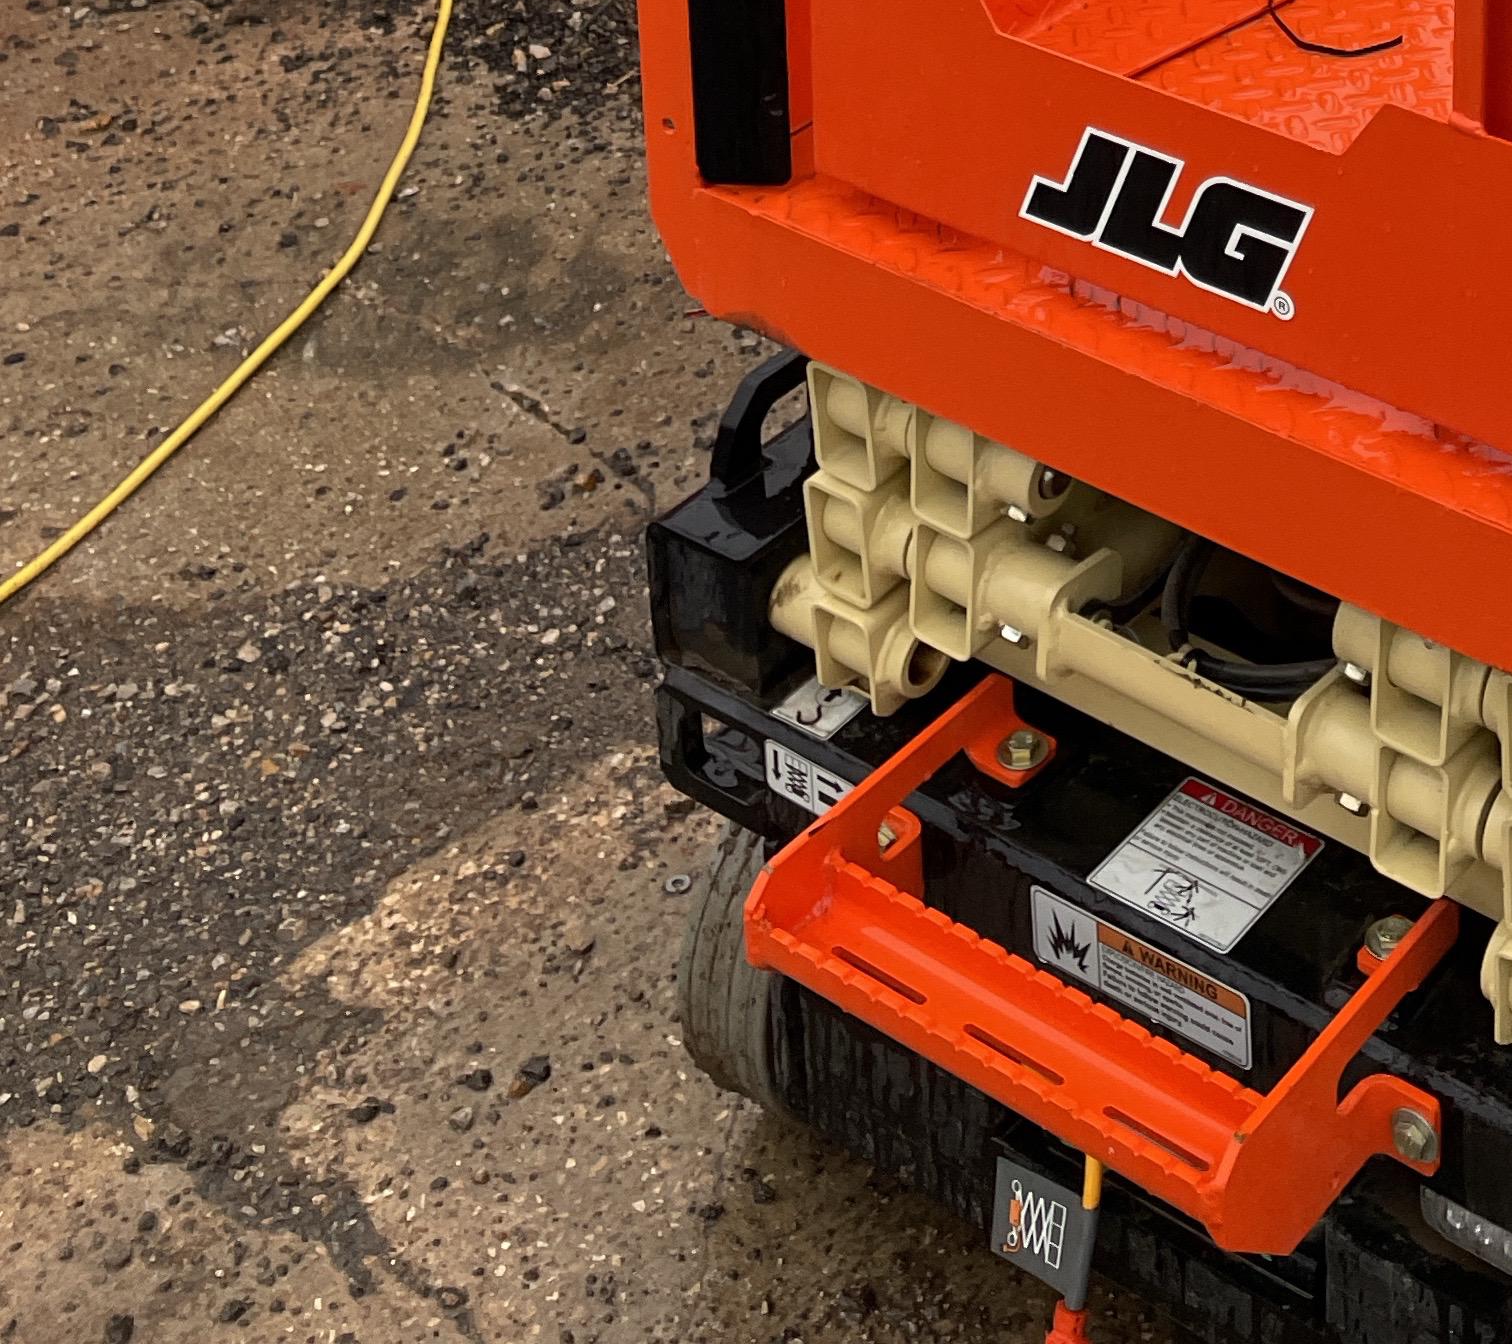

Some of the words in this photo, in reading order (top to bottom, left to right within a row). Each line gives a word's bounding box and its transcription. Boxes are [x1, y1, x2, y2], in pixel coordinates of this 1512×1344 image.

[1018, 126, 1315, 313] JLG
[1220, 798, 1299, 847] DANGER
[1139, 946, 1219, 1001] WARNING
